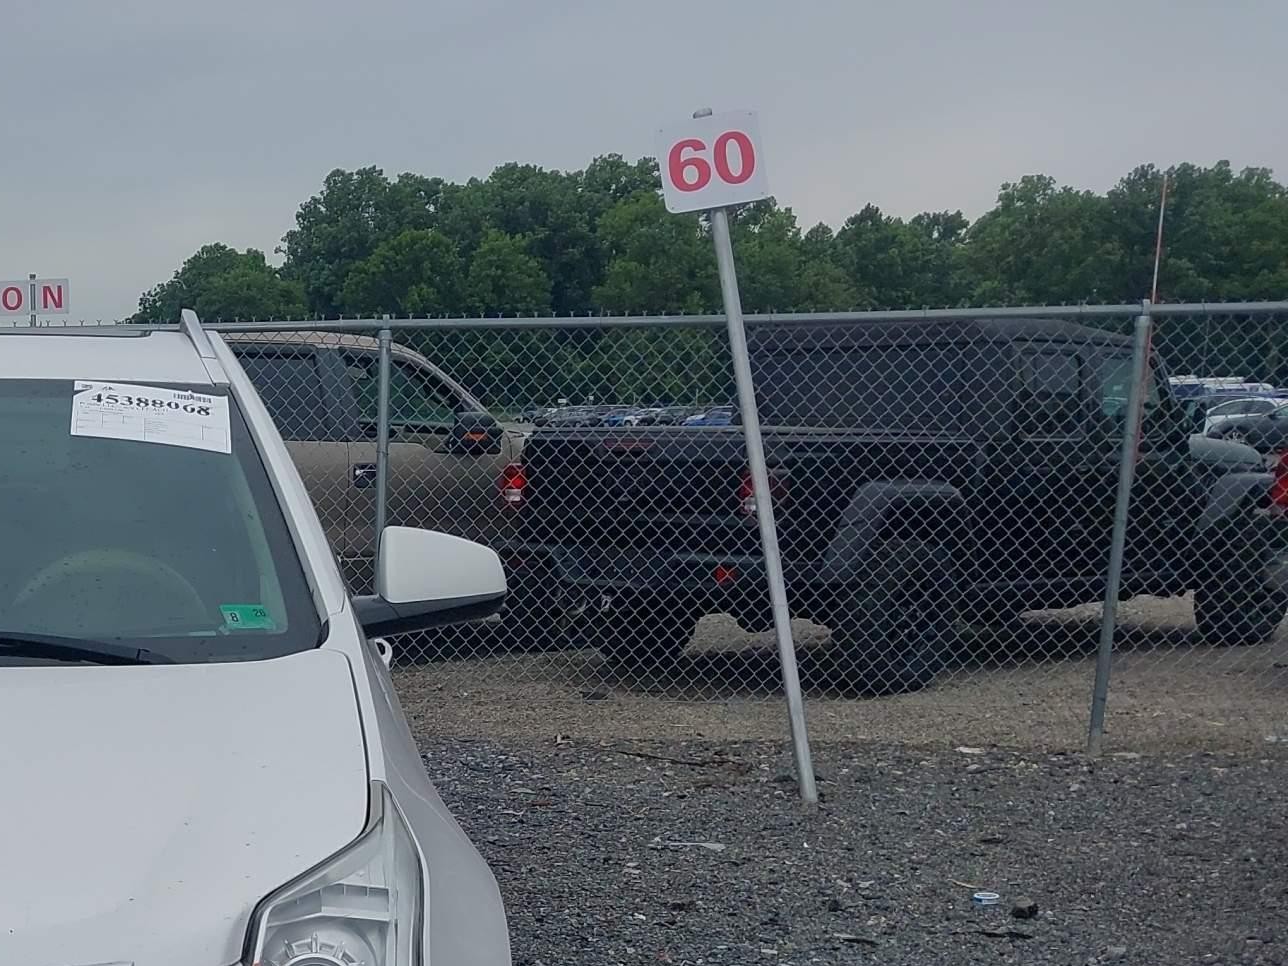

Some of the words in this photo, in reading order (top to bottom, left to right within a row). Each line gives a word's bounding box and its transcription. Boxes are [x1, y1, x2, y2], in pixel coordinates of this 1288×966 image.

[668, 130, 756, 192] 60
[1, 286, 23, 311] O
[42, 285, 63, 309] N
[91, 392, 211, 417] 45388068
[230, 611, 239, 622] 8
